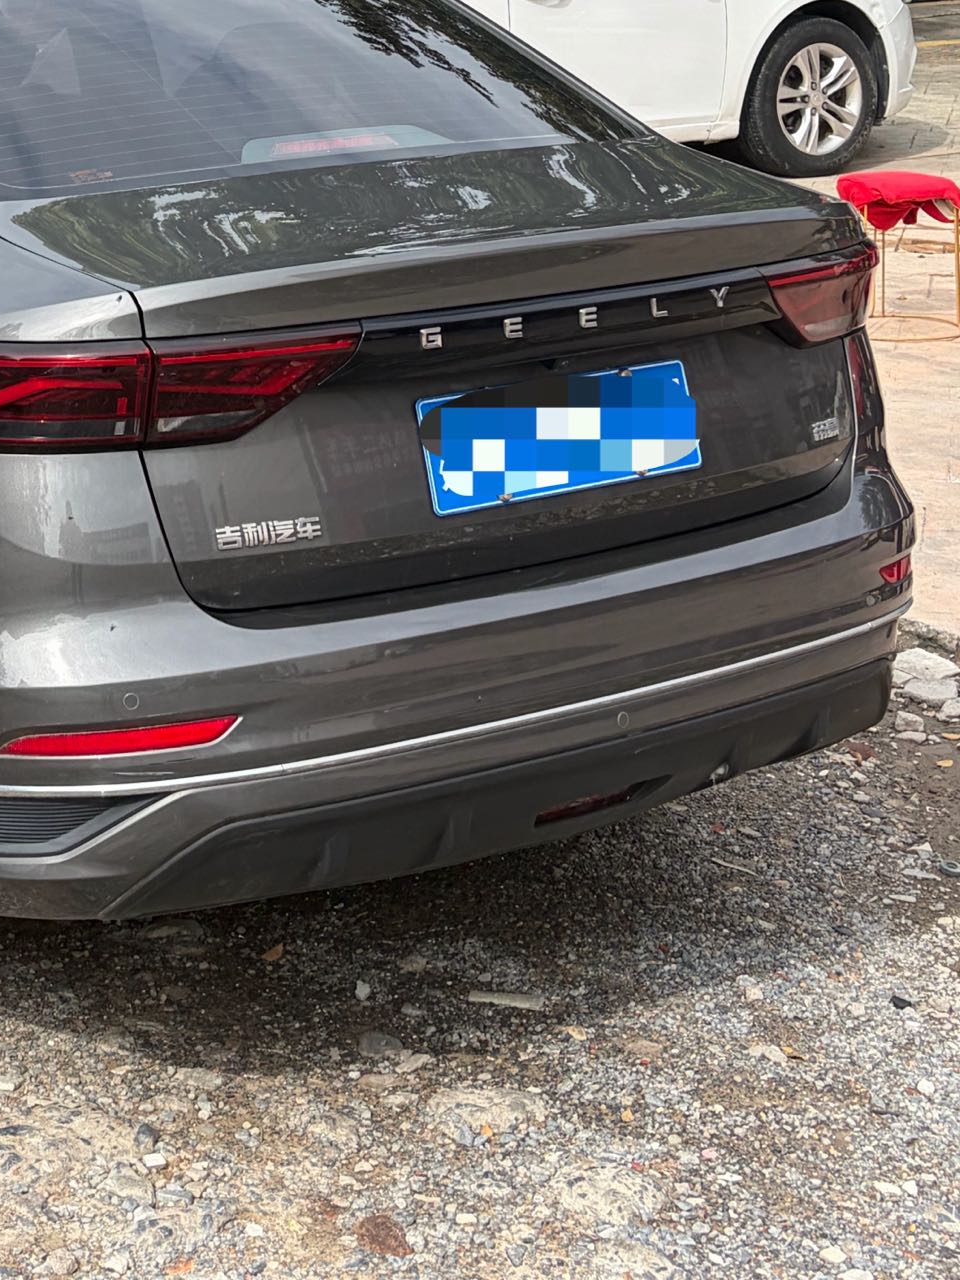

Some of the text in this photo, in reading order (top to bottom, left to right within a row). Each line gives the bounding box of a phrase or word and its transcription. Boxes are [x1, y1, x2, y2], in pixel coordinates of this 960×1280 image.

[419, 286, 729, 351] GEELY
[215, 516, 322, 551] 吉利汽车
